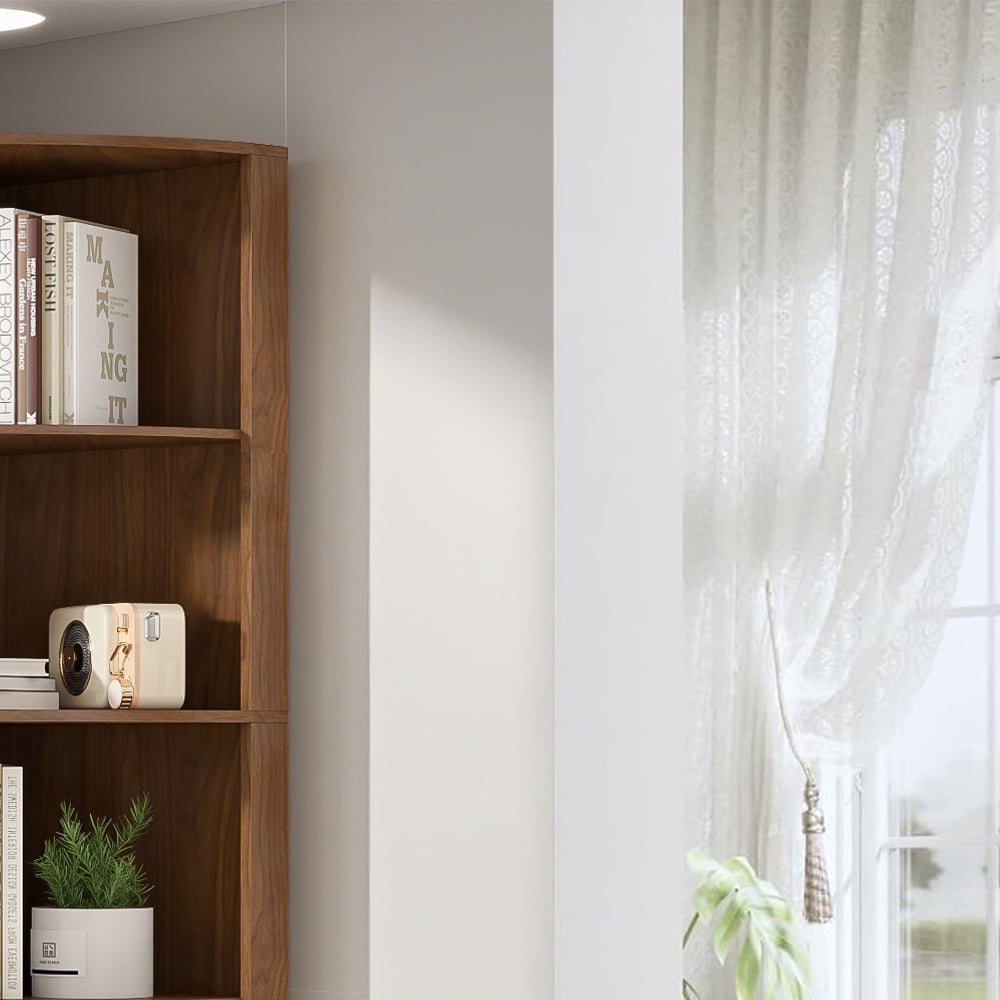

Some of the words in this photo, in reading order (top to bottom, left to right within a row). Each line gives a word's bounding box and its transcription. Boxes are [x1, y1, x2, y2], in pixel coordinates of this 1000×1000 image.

[0, 214, 13, 287] ALEXEY
[44, 222, 56, 268] LOST
[65, 231, 74, 283] MAKING
[18, 278, 27, 322] Gardens
[44, 273, 56, 313] FISH
[66, 285, 74, 300] IT
[18, 323, 27, 334] in
[0, 293, 13, 415] BRODOVITCH
[18, 335, 27, 371] France
[107, 396, 127, 425] IT
